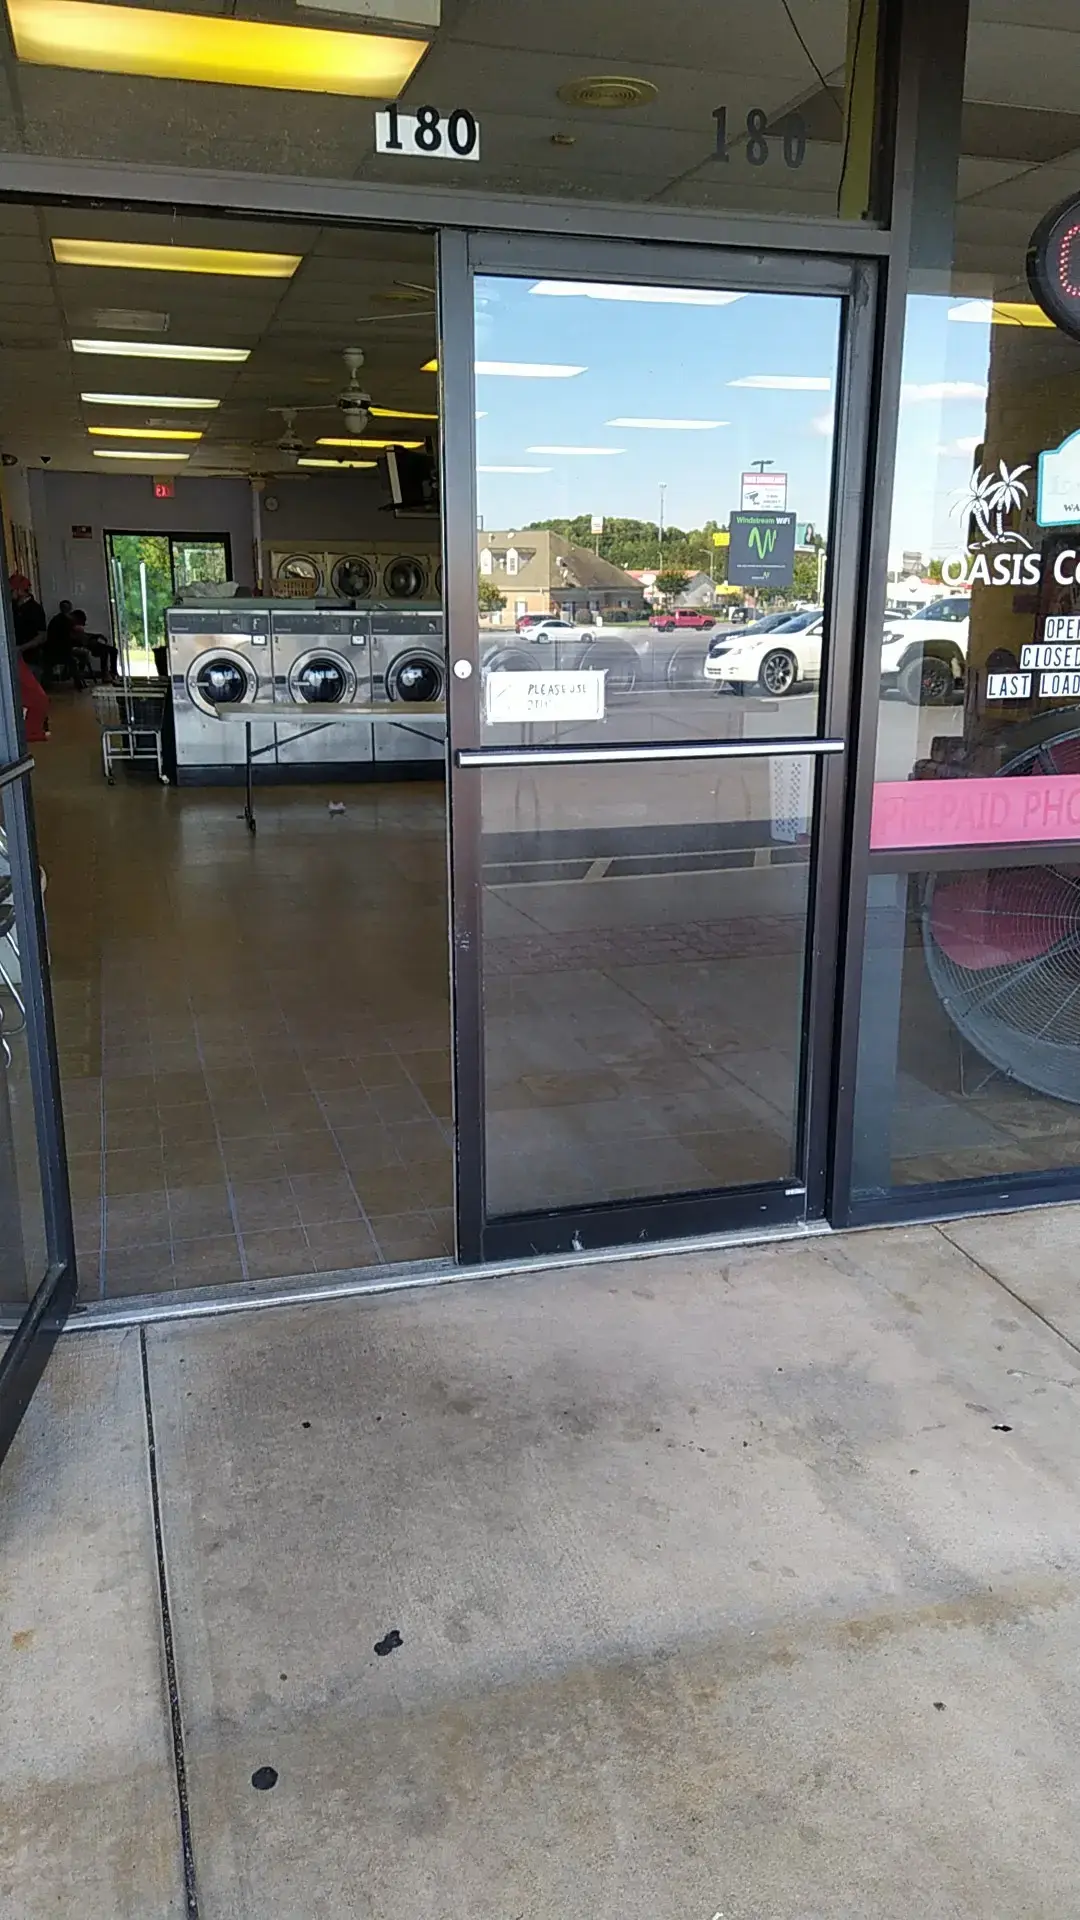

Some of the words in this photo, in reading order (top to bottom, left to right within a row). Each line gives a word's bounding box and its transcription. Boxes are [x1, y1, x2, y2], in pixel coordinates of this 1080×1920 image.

[384, 103, 477, 156] 180
[712, 106, 806, 169] 180
[736, 516, 775, 525] Windstream
[941, 553, 1042, 587] OASIS
[1053, 549, 1080, 586] C
[527, 683, 566, 696] PLEASE
[988, 675, 1030, 696] LAST
[1041, 674, 1080, 695] LOAD
